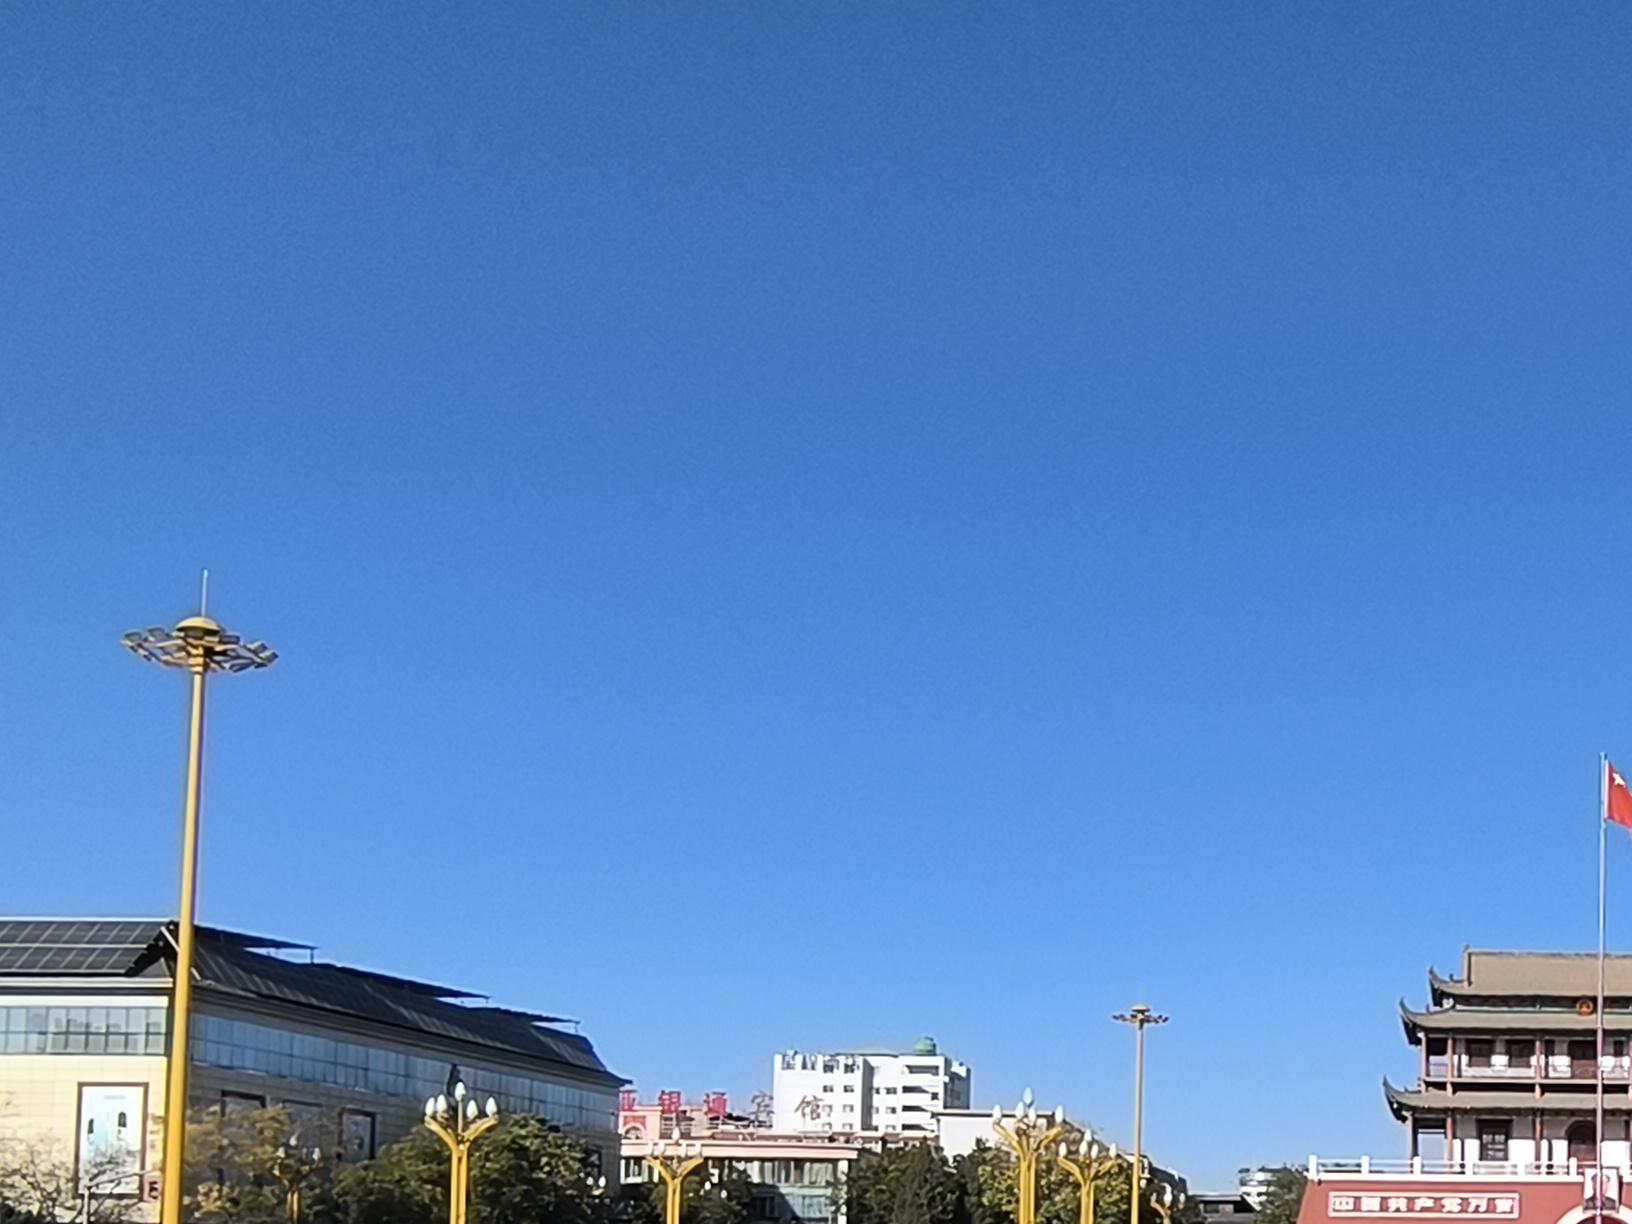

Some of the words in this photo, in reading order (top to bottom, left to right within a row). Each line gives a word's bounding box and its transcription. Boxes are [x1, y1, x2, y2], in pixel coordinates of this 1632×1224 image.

[1333, 1195, 1514, 1213] 中国共产党万岁
